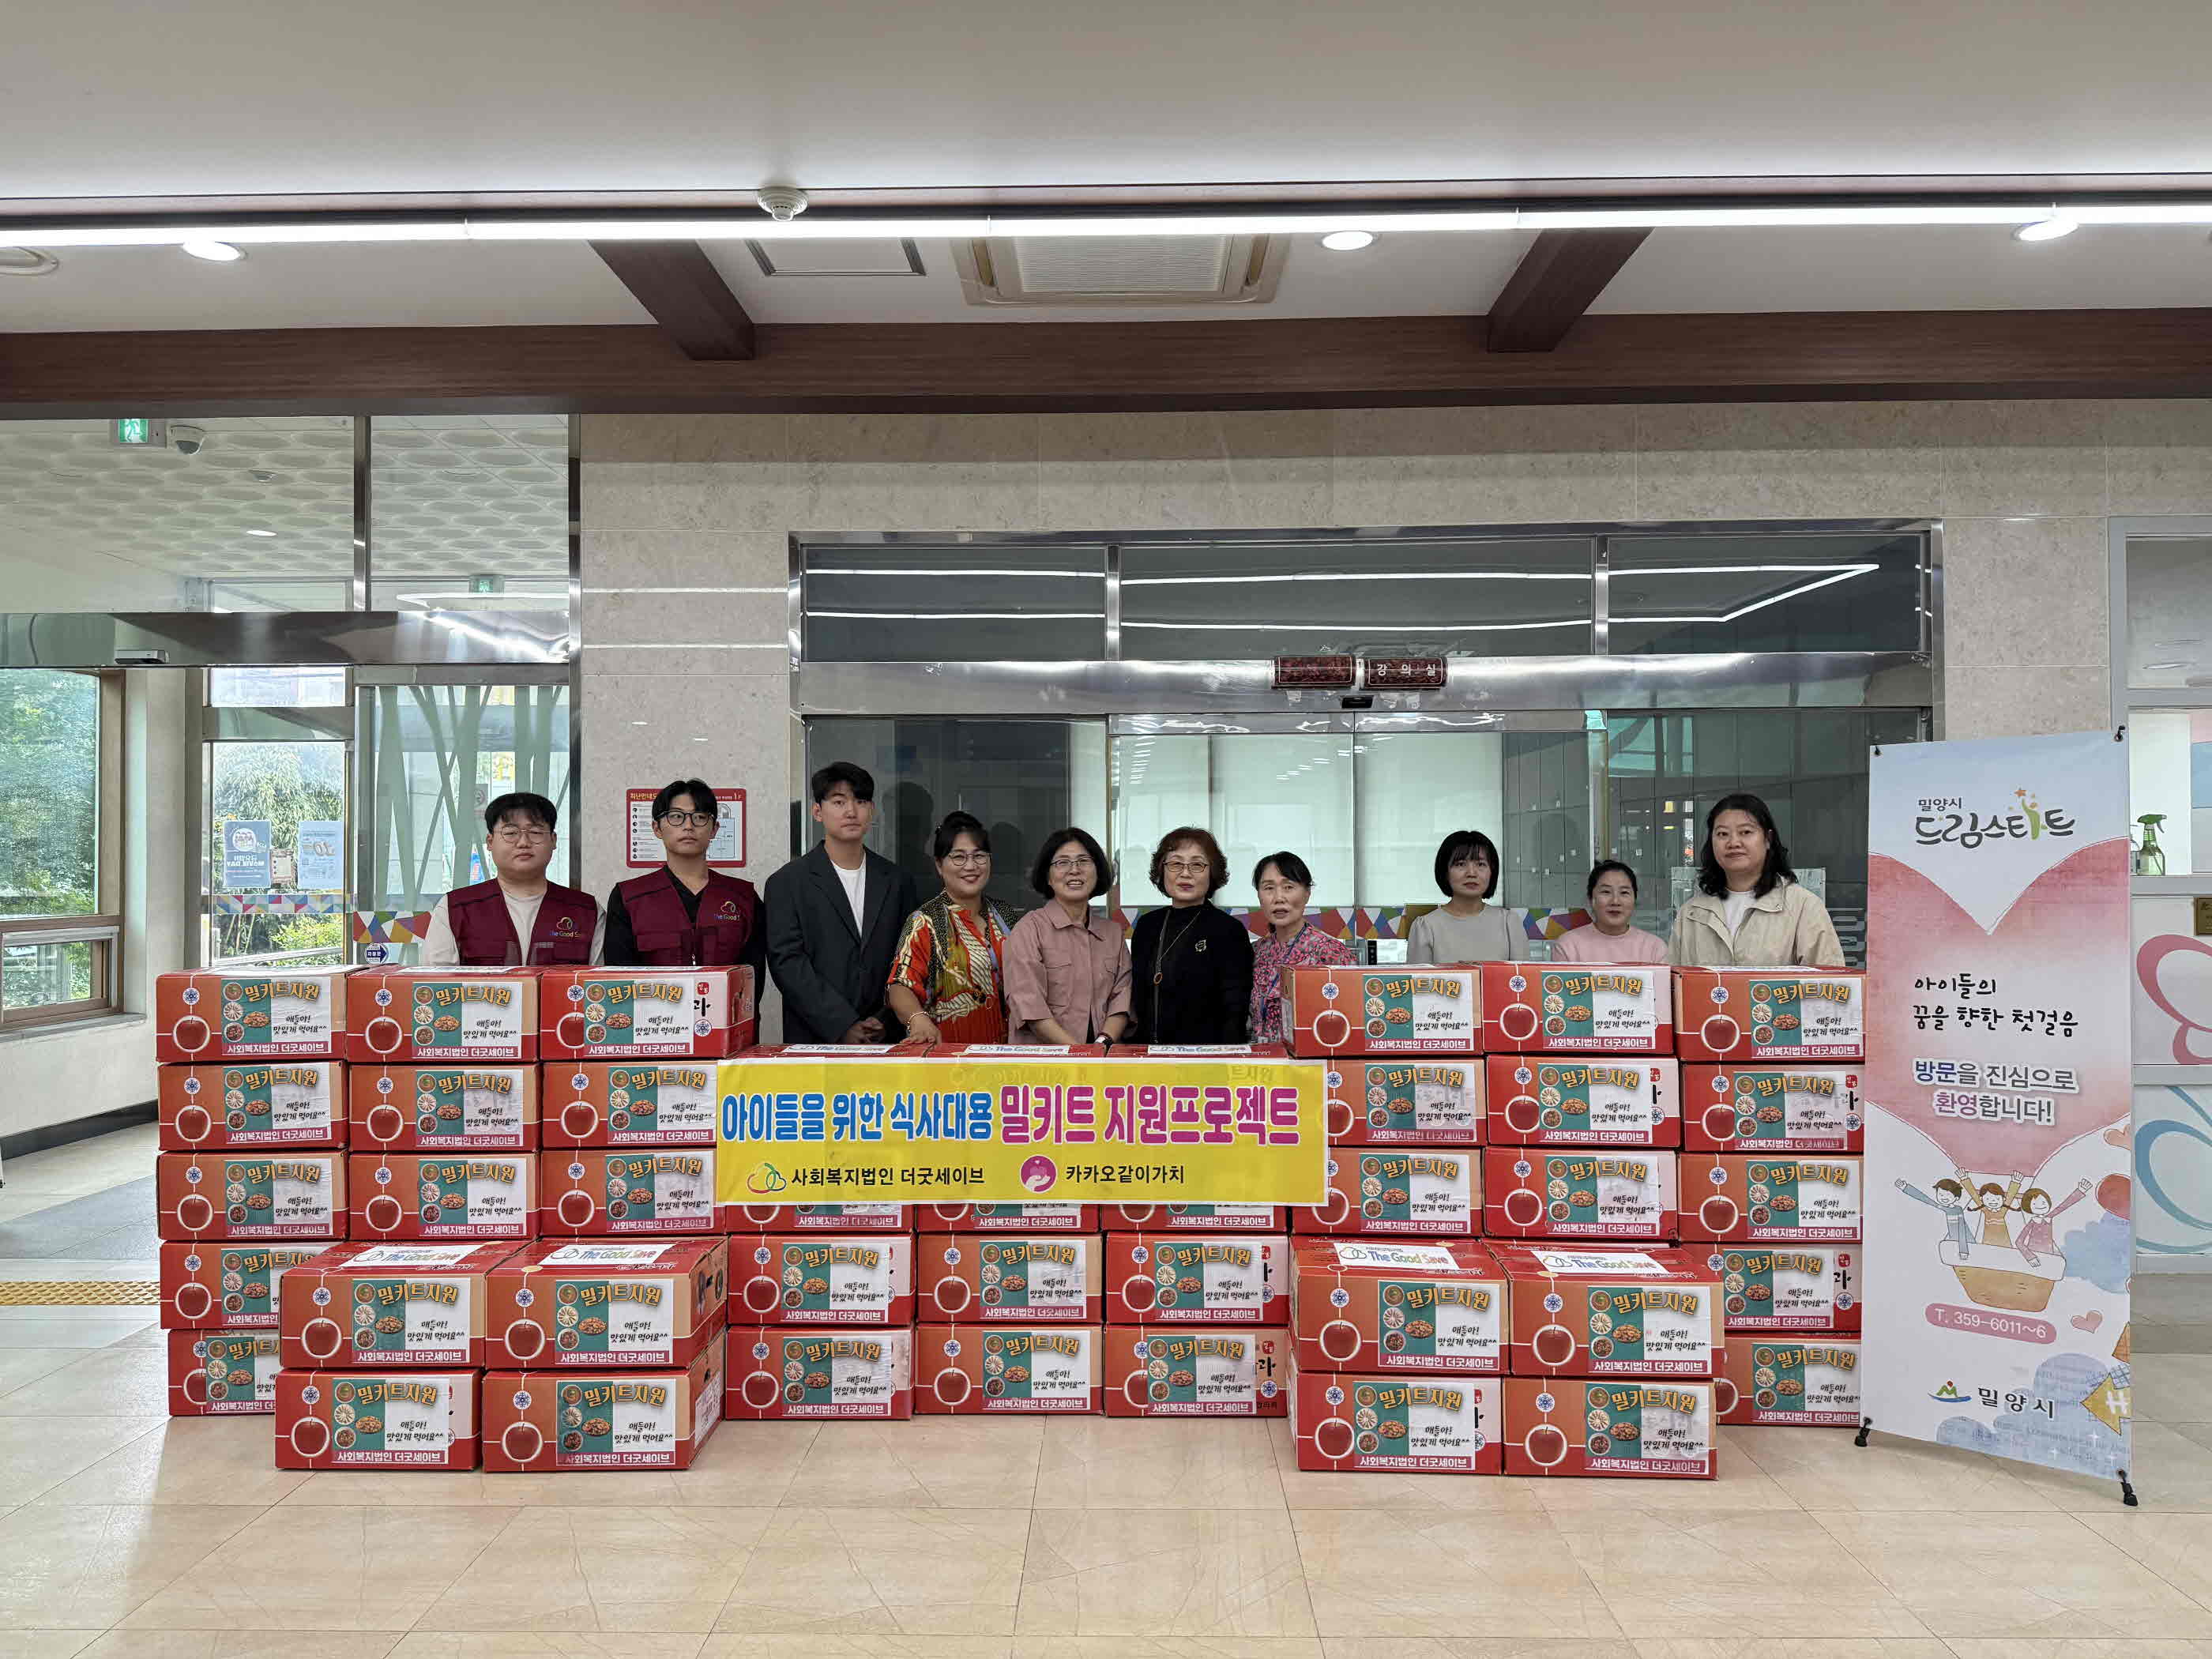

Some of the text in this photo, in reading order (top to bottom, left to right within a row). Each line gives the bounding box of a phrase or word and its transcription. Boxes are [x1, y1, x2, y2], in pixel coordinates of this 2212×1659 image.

[1377, 664, 1436, 676] 강의실
[1918, 797, 1962, 811] 밀양시
[1915, 799, 2075, 848] 드림스타트
[245, 981, 321, 1003] 밀키트지원
[436, 986, 512, 1007] 밀키트지원
[608, 983, 683, 1003] 밀키트지원
[1386, 978, 1462, 999] 밀키트지원
[1565, 976, 1643, 996] 밀키트지원
[1774, 983, 1850, 1004] 밀키트지원
[1914, 973, 1997, 999] 아이들의
[1913, 1005, 2078, 1038] 꿈을 향한 첫걸음
[227, 1043, 324, 1052] 사회복지법인 더굿세이브
[589, 1044, 686, 1054] 사회복지법인 더굿세이브
[1548, 1038, 1648, 1047] 사회복지법인 더굿세이브
[1756, 1046, 1856, 1055] 사회복지법인 더굿세이브
[246, 1068, 318, 1090] 밀키트지원
[438, 1074, 513, 1095] 밀키트지원
[632, 1070, 707, 1090] 밀키트지원
[1388, 1068, 1464, 1089] 밀키트지원
[1562, 1068, 1639, 1090] 밀키트지원
[1757, 1076, 1835, 1097] 밀키트지원
[1915, 1061, 2076, 1091] 방문을 진심으로
[722, 1085, 1300, 1145] 아이들을 위한 식사대용 밀키트 지원프로젝트
[1936, 1093, 2052, 1123] 환영합니다!
[1544, 1131, 1645, 1142] 사회복지법인 더굿세이브
[247, 1163, 321, 1184] 밀키트지원
[442, 1163, 516, 1183] 밀키트지원
[629, 1157, 703, 1179] 밀키트지원
[791, 1168, 985, 1186] 사회복지법인 더굿세이브
[1066, 1165, 1184, 1184] 카카오같이가치
[1383, 1158, 1459, 1180] 밀키트지원
[1570, 1161, 1647, 1183] 밀키트지원
[1771, 1164, 1849, 1187] 밀키트지원
[799, 1217, 896, 1226] 사회복지법인 더굿세이브
[979, 1217, 1074, 1226] 사회복지법인 더굿세이브
[1172, 1216, 1267, 1225] 사회복지법인 더굿세이브
[1753, 1228, 1853, 1237] 사회복지법인 더굿세이브
[805, 1247, 879, 1269] 밀키트지원
[1003, 1244, 1076, 1266] 밀키트지원
[1177, 1246, 1252, 1267] 밀키트지원
[1367, 1251, 1448, 1264] The Good Save
[1747, 1254, 1823, 1276] 밀키트지원
[378, 1283, 459, 1306] 밀키트지원
[581, 1284, 662, 1307] 밀키트지원
[1407, 1287, 1490, 1312] 밀키트지원
[1613, 1292, 1698, 1315] 밀키트지원
[786, 1311, 881, 1320] 사회복지법인 더굿세이브
[408, 1333, 432, 1341] 맛있게
[611, 1334, 635, 1342] 맛있게
[1006, 1335, 1080, 1356] 밀키트지원
[1646, 1342, 1672, 1351] 맛있게
[229, 1340, 279, 1360] 밀키트
[358, 1352, 461, 1361] 사회복지법인 더굿세이브
[561, 1352, 664, 1362] 사회복지법인 더굿세이브
[806, 1341, 882, 1362] 밀키트지원
[1170, 1339, 1244, 1360] 밀키트지원
[1777, 1349, 1856, 1371] 밀키트지원
[1386, 1356, 1493, 1368] 사회복지법인 더굿세이브
[1594, 1361, 1703, 1371] 사회복지법인 더굿세이브
[357, 1383, 438, 1406] 밀키트지원
[585, 1385, 667, 1408] 밀키트지원
[988, 1399, 1082, 1408] 사회복지법인 더굿세이브
[1379, 1387, 1463, 1412] 밀키트지원
[1612, 1389, 1697, 1415] 밀키트지원
[1978, 1386, 2054, 1420] 밀양시
[211, 1401, 262, 1411] 사회복지법인
[1206, 1403, 1248, 1412] 더굿세이브
[1411, 1439, 1436, 1447] 맛있게
[337, 1451, 440, 1462] 사회복지법인 더굿세이브
[1360, 1456, 1467, 1468] 사회복지법인 더굿세이브
